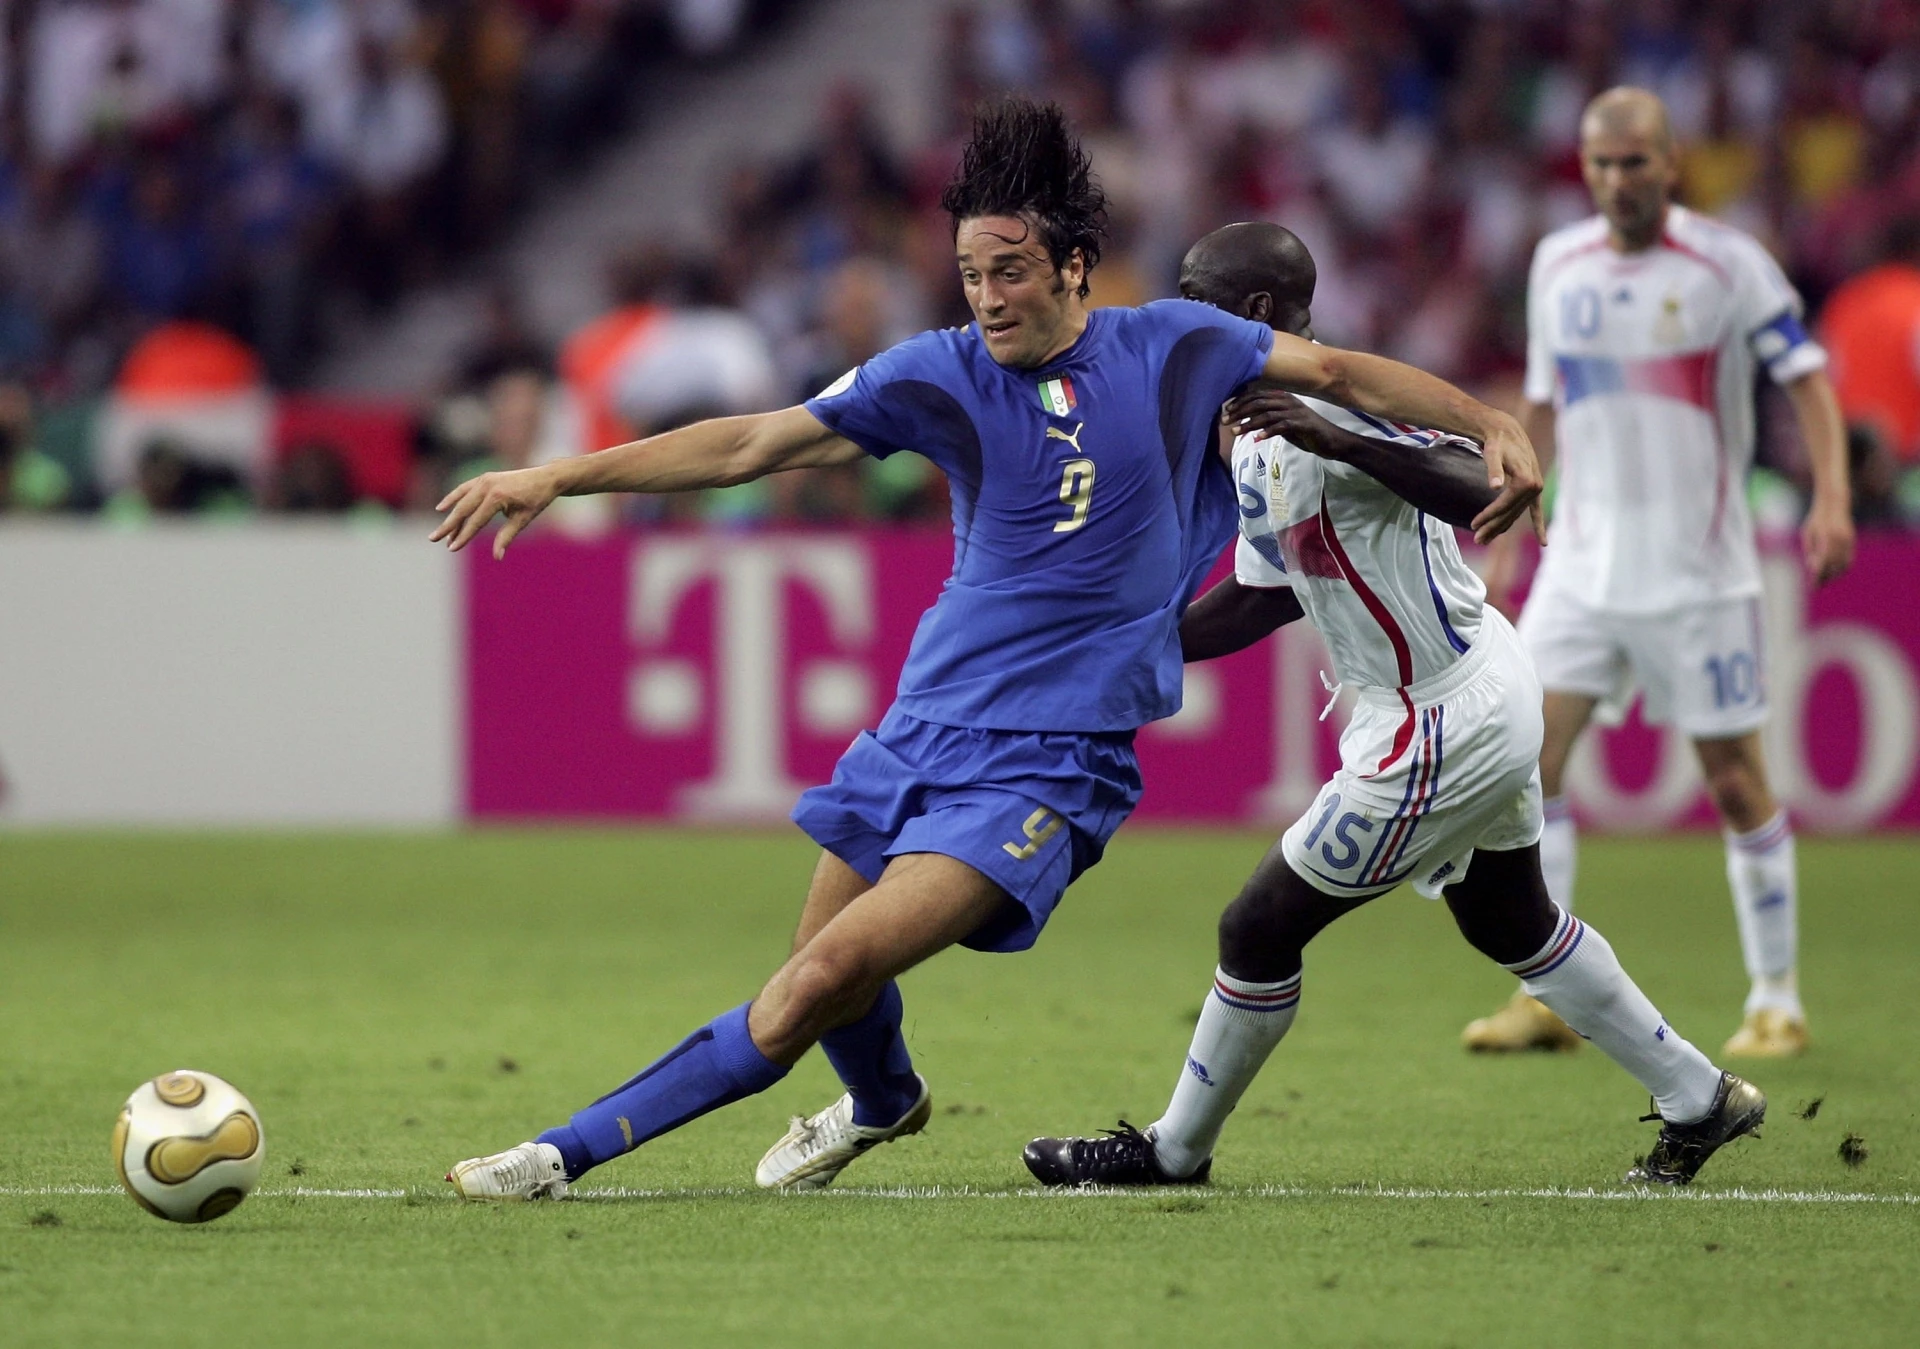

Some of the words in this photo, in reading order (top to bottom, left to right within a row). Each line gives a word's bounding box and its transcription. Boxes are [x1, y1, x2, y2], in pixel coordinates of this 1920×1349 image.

[1559, 285, 1602, 341] 10
[1053, 459, 1095, 532] 9
[1234, 456, 1267, 518] 5
[1704, 652, 1755, 708] 10
[1002, 807, 1065, 860] 9
[1303, 793, 1374, 870] 15
